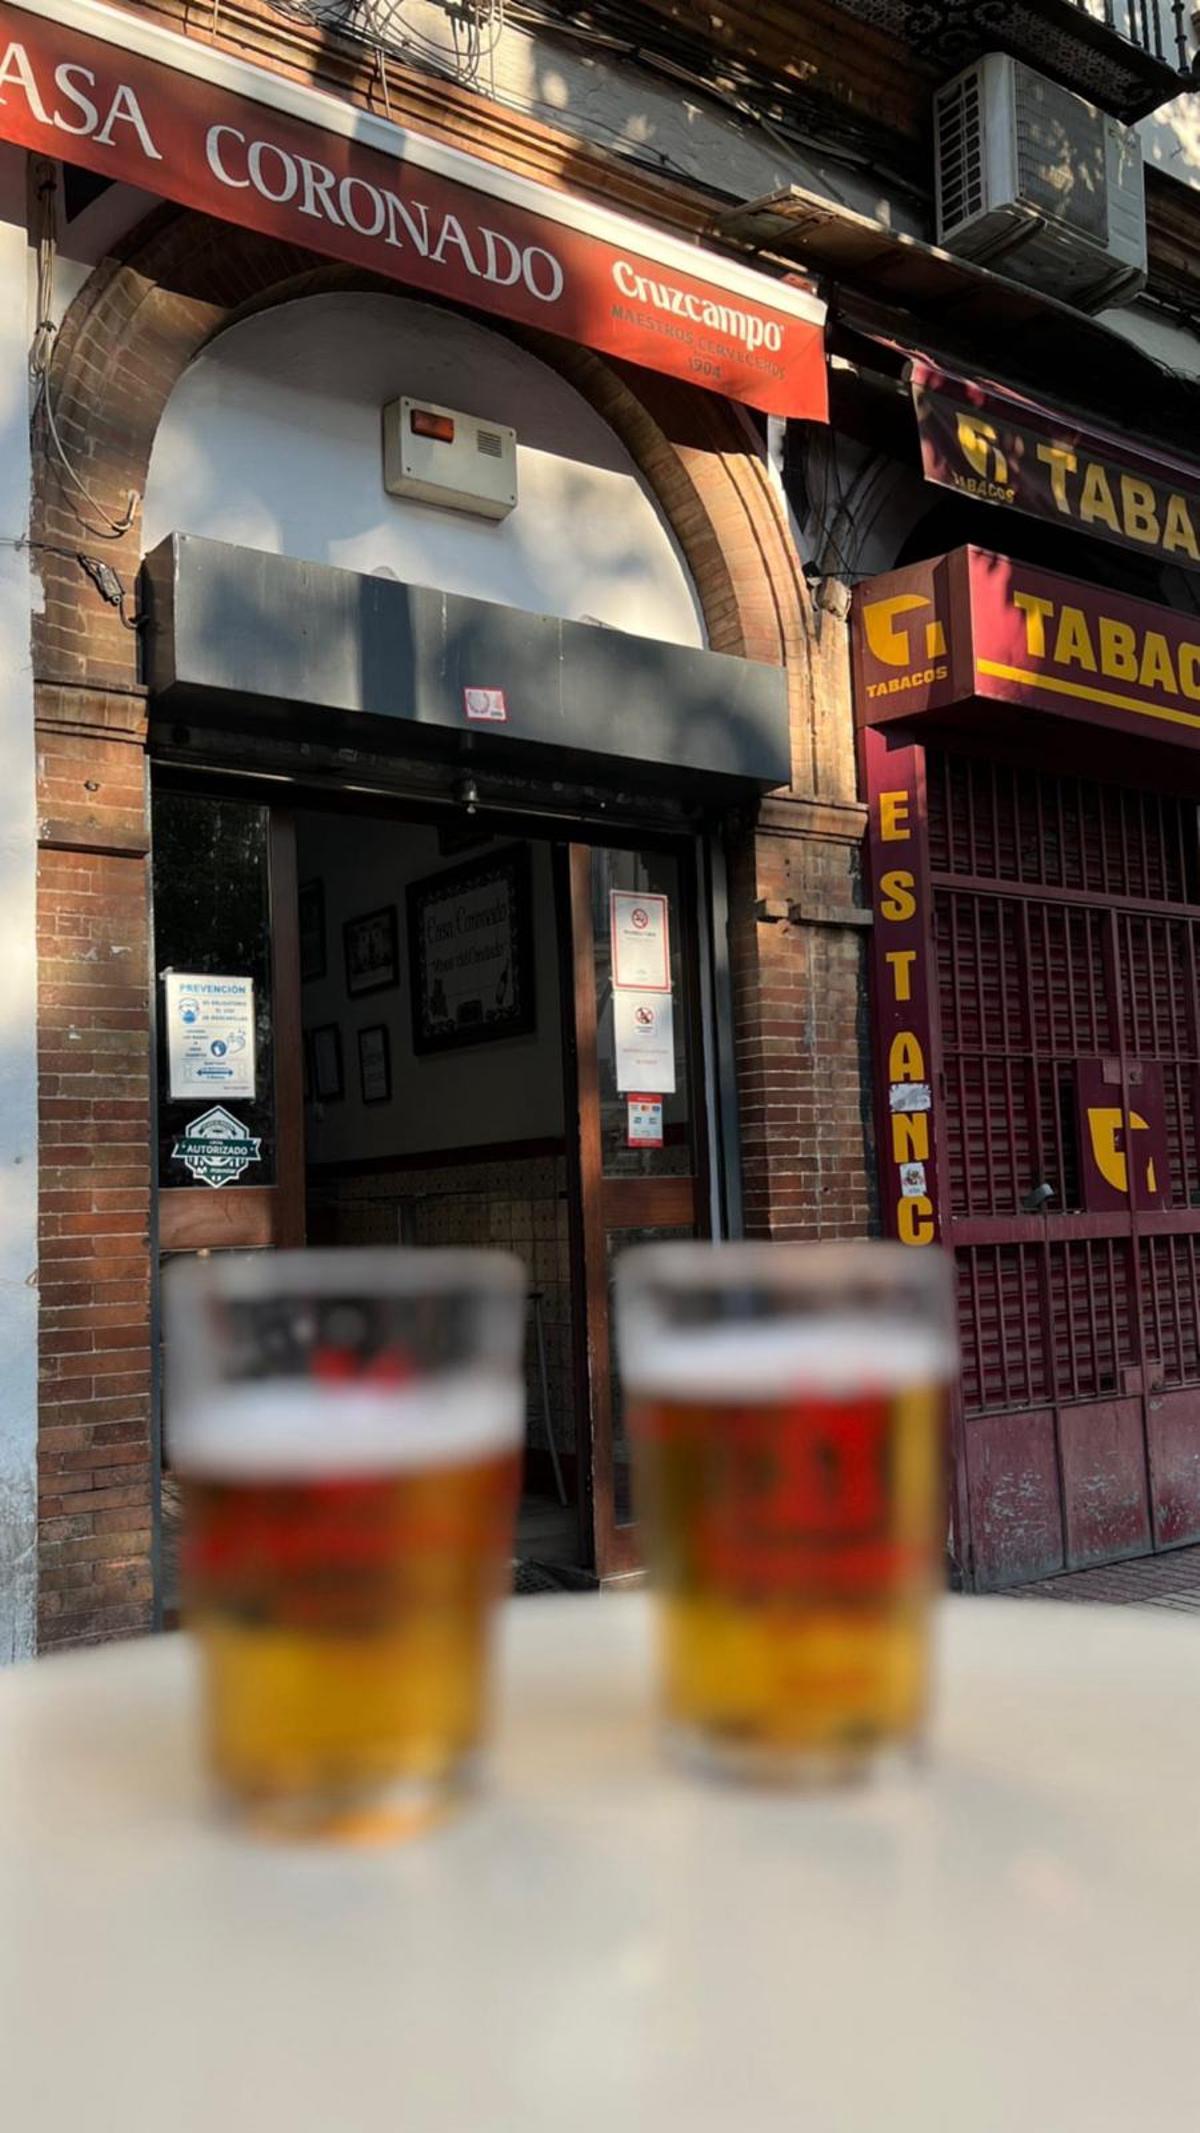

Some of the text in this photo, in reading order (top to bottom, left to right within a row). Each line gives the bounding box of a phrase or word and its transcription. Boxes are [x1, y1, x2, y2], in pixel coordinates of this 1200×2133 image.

[206, 124, 563, 301] CORONADO
[611, 304, 694, 344] MAESTROS
[612, 260, 783, 352] Cruzcampo
[688, 356, 722, 379] 1904
[1037, 442, 1200, 560] TABA
[866, 666, 948, 698] TABACOS
[179, 983, 246, 994] PREVENCIÓN
[187, 1143, 248, 1156] AUTORIZADO
